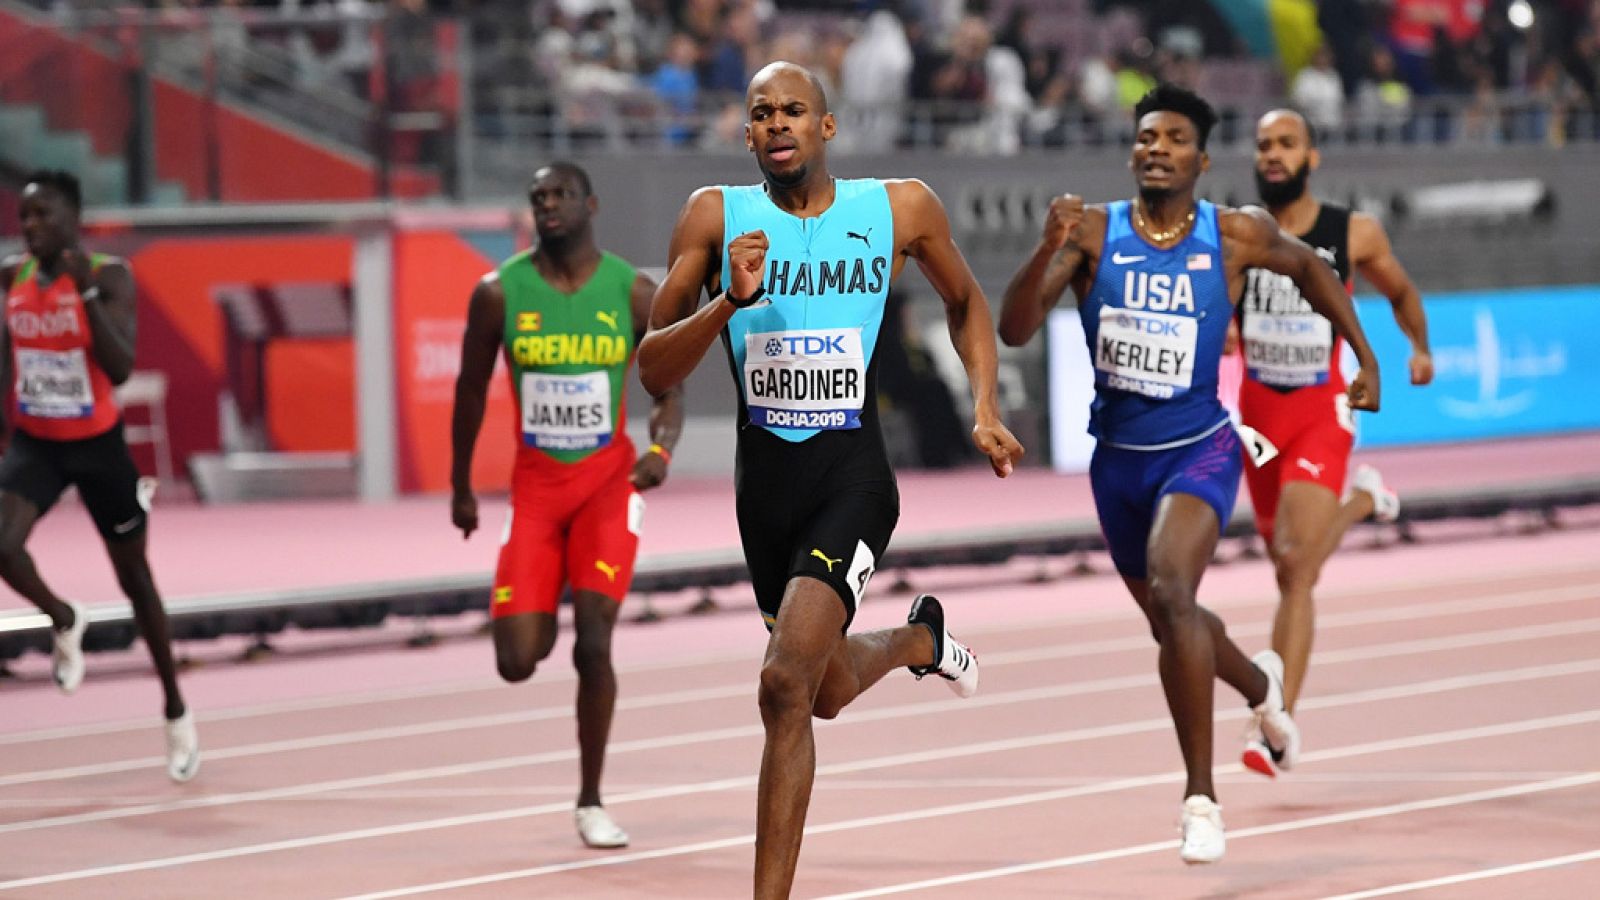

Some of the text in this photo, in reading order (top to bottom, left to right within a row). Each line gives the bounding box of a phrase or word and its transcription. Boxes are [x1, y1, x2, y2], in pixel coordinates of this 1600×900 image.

[1123, 270, 1195, 312] USA
[1134, 317, 1181, 336] TDK
[513, 333, 627, 366] GRENADA
[782, 335, 846, 354] TDK
[1101, 335, 1187, 375] KERLEY
[552, 380, 594, 396] TDK
[751, 368, 858, 400] GARDINER
[527, 402, 604, 429] JAMES
[766, 410, 846, 428] DOHA2019
